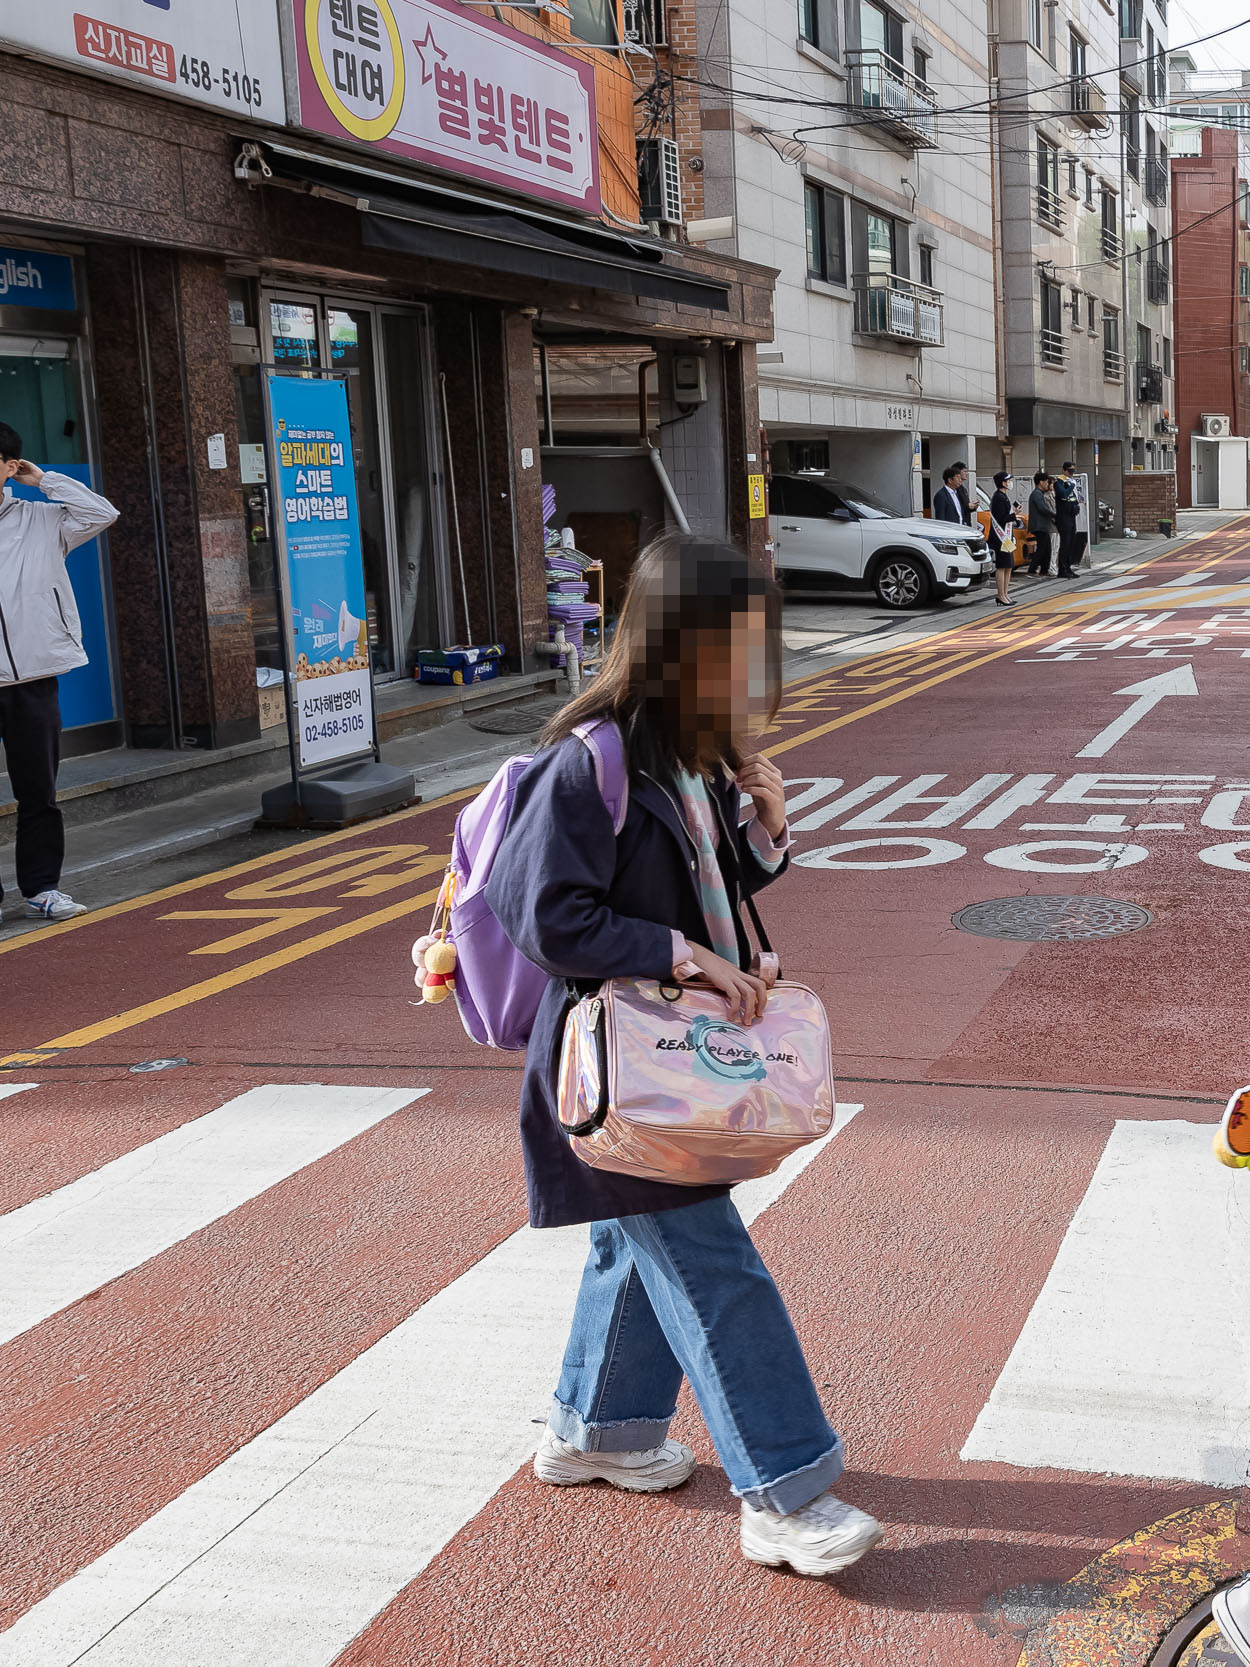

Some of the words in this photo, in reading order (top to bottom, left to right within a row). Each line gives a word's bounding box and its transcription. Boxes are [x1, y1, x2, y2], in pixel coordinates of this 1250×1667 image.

[329, 0, 381, 51] 텐트
[84, 22, 169, 78] 신자교실
[180, 54, 262, 107] 458-5105
[333, 48, 385, 107] 대여
[434, 62, 574, 174] 별빛텐트
[280, 442, 344, 467] 알파세대의
[296, 470, 333, 493] 스마트
[285, 496, 348, 523] 영어학습법
[303, 688, 362, 718] 신자해법영어
[305, 714, 364, 742] 02-458-5105
[656, 1038, 704, 1054] READY
[708, 1045, 761, 1061] PLAYER
[765, 1052, 799, 1067] ONE!
